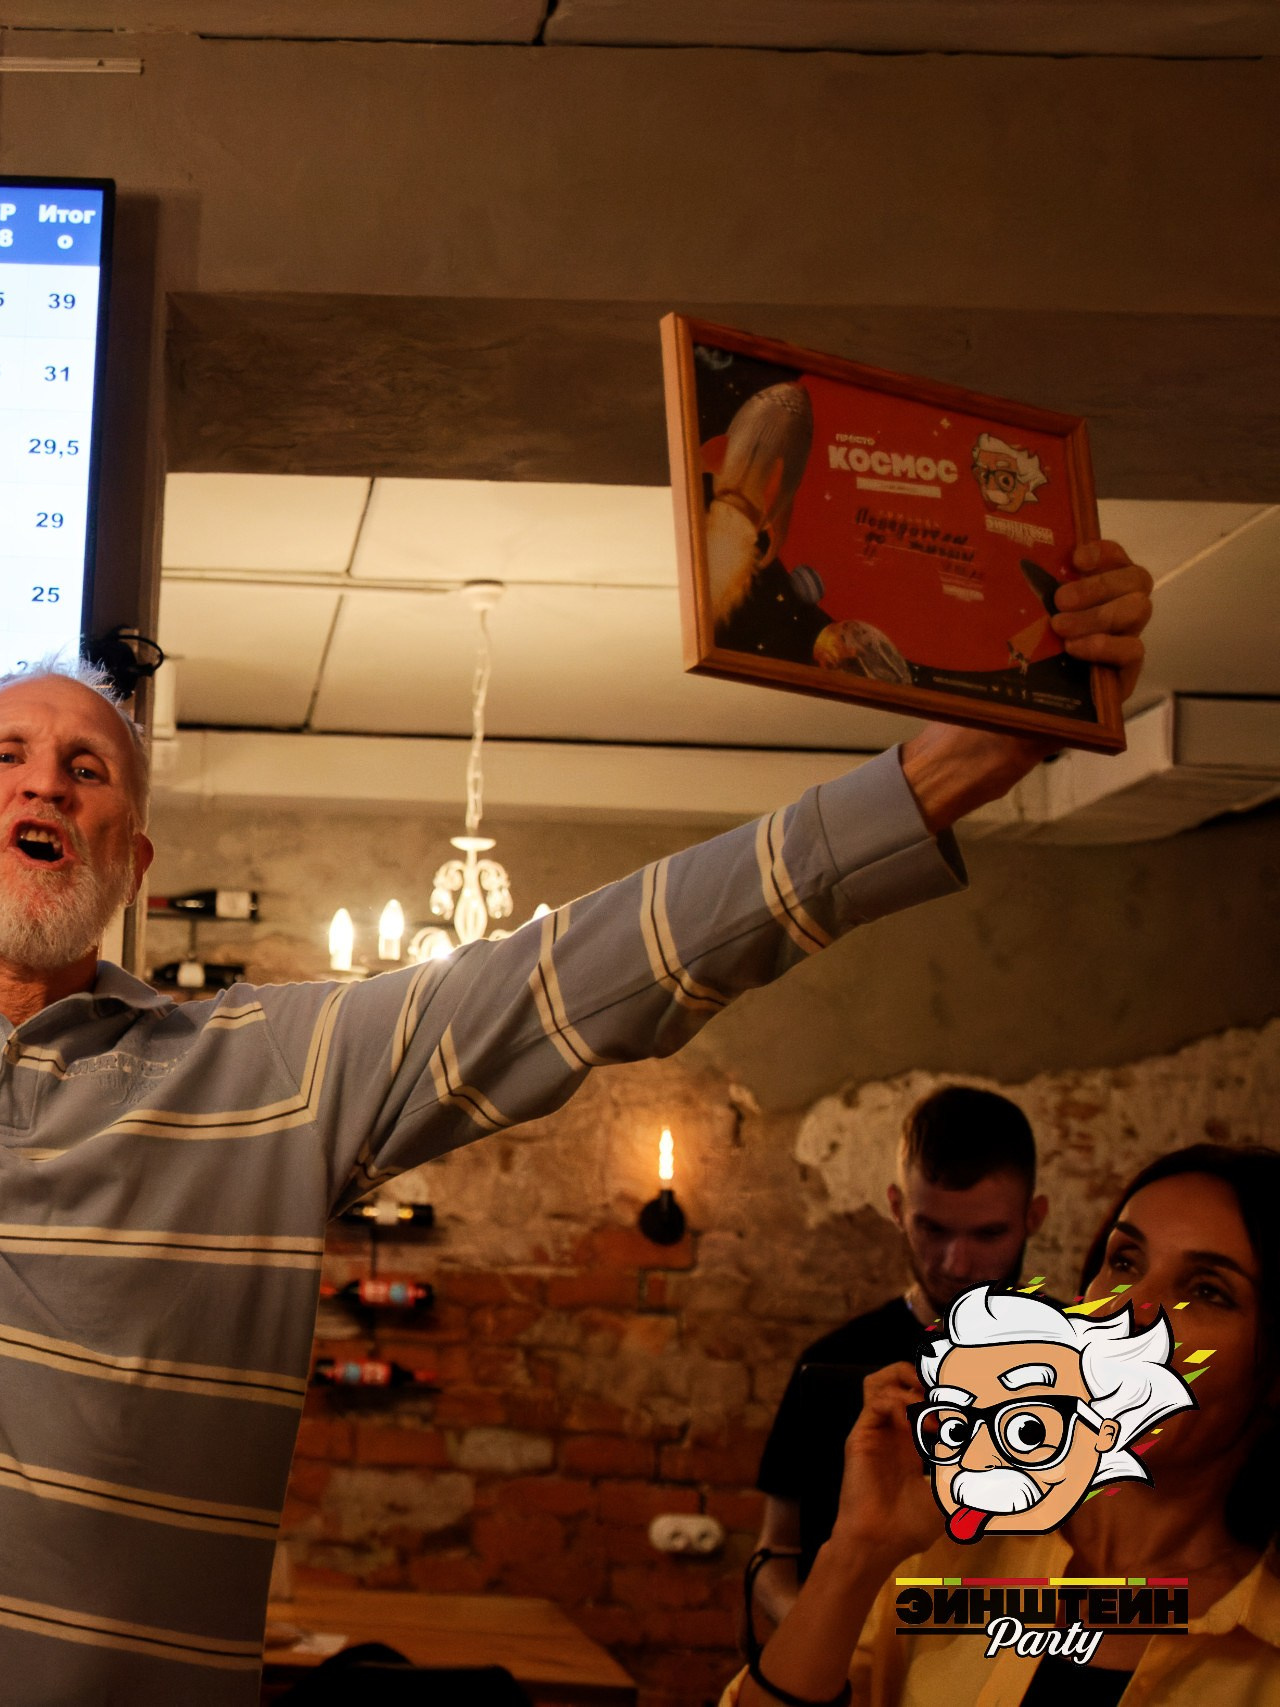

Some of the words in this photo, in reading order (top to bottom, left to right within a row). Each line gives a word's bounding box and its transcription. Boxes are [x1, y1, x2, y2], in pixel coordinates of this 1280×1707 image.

[38, 204, 96, 224] Итог
[57, 234, 74, 250] о
[48, 292, 77, 310] 39
[44, 364, 70, 383] 31
[28, 437, 80, 459] 29,5
[827, 444, 959, 484] КОСМОС
[35, 511, 65, 529] 29
[31, 585, 61, 604] 25
